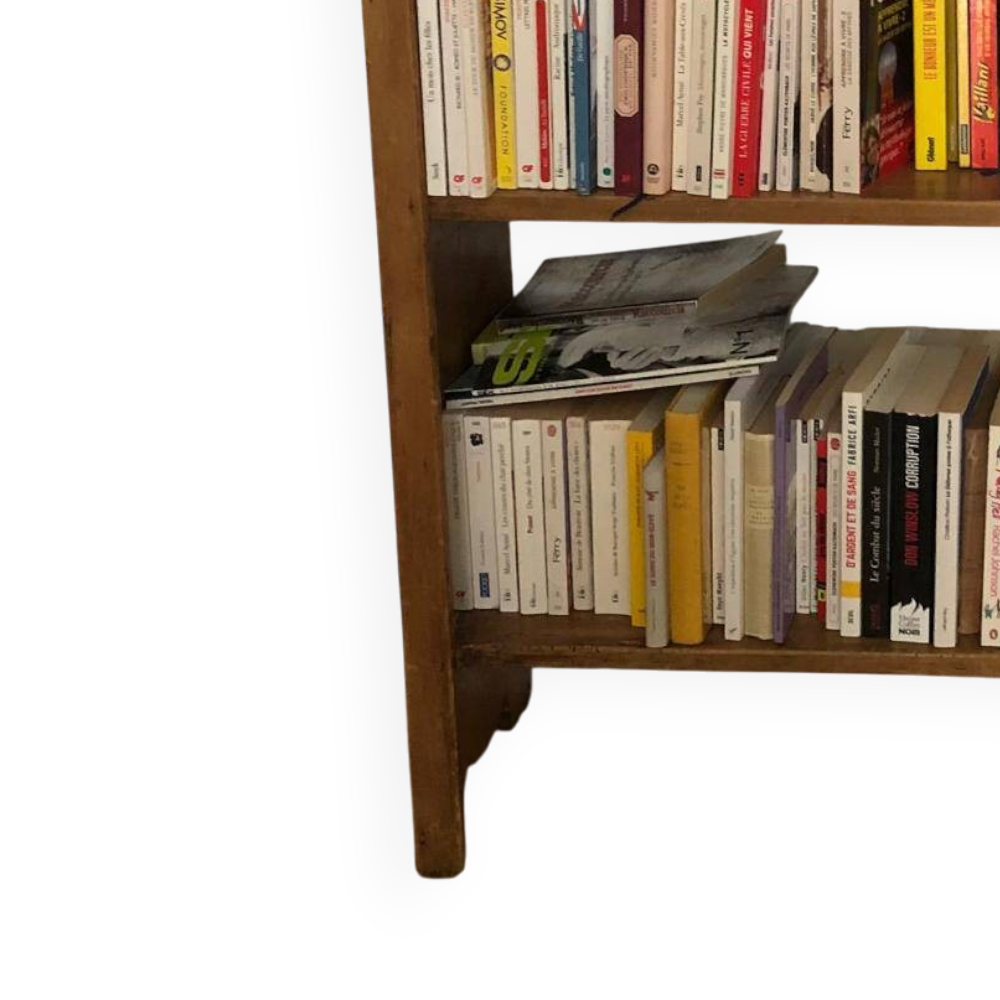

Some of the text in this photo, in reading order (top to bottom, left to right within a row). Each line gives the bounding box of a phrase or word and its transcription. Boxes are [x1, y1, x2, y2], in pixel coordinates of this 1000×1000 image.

[923, 11, 936, 21] UN
[923, 24, 936, 35] EST
[678, 64, 685, 74] La
[923, 38, 936, 70] BONHEUR
[739, 8, 754, 158] LA GUERRE CIVILE QUI VIENT
[923, 72, 936, 80] LE
[972, 61, 995, 124] Vaillant
[500, 85, 509, 156] FOUNDATION
[676, 102, 685, 127] Marcel
[842, 107, 853, 139] Ferry
[926, 137, 935, 162] Glénat
[847, 405, 857, 465] FABRICE ARFI
[905, 425, 920, 566] DON WINSLOW CORRUPTION
[846, 471, 857, 568] D'ARGENT ET DE SANG
[869, 487, 881, 582] Le Combat du siècle
[552, 536, 561, 563] Ferry
[990, 556, 1000, 596] Johnson
